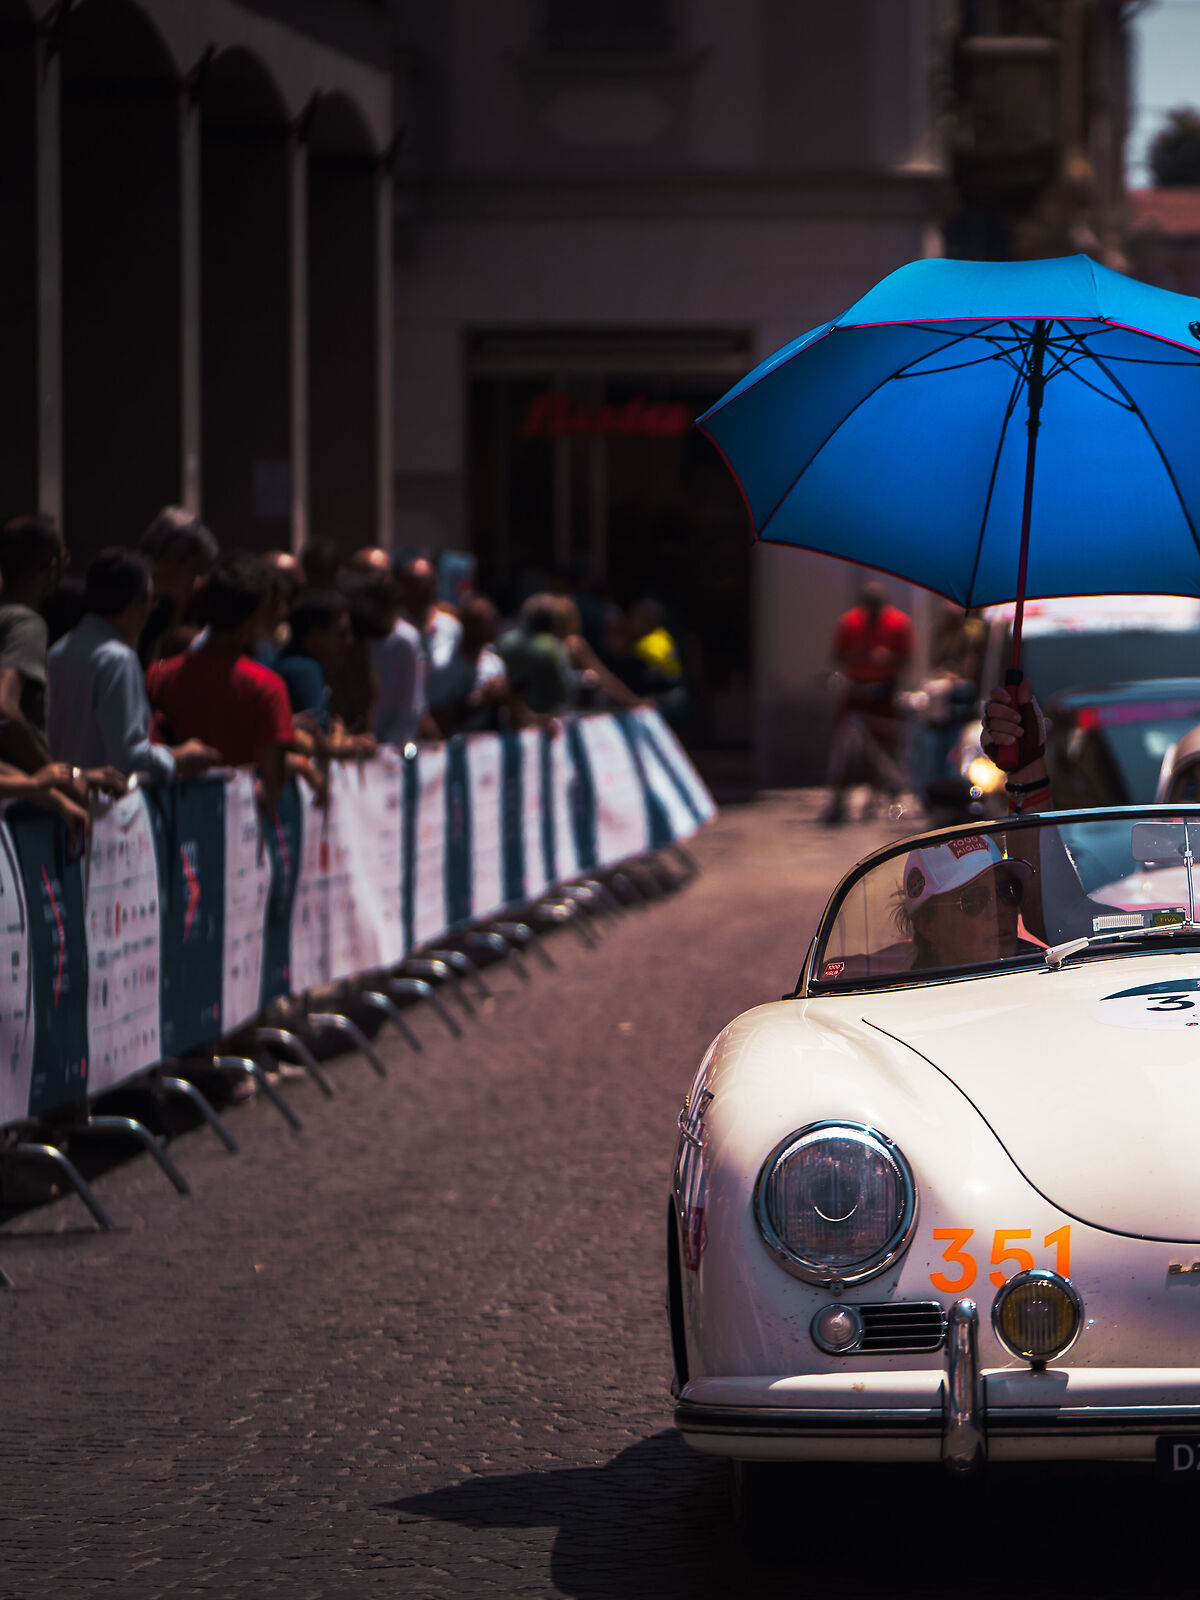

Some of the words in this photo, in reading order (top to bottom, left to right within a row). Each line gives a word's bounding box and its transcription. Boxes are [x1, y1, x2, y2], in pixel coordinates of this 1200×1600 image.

[953, 836, 979, 848] 1000
[956, 843, 986, 856] MIGLIA
[929, 1225, 1071, 1293] 351
